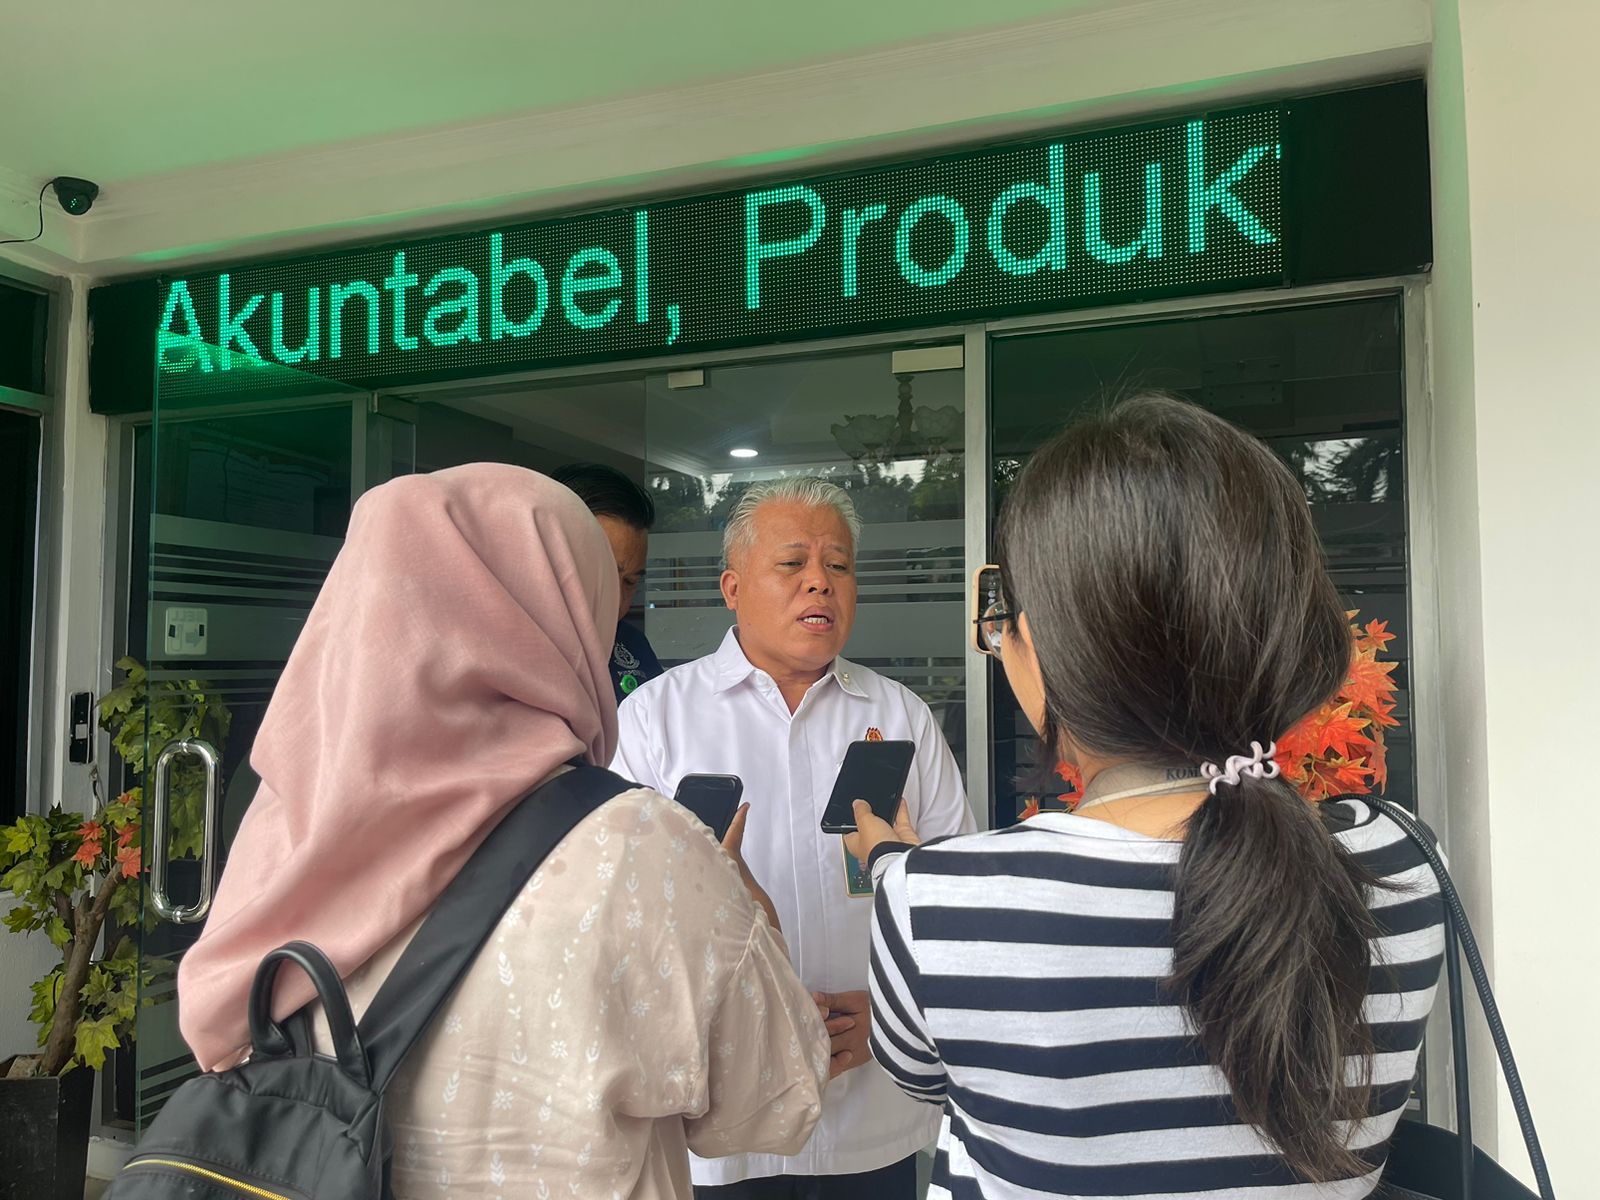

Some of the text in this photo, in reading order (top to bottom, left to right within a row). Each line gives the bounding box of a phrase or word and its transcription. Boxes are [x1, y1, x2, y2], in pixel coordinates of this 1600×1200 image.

[158, 120, 1280, 373] Akuntabel, Produk
[1166, 766, 1201, 781] KOM
